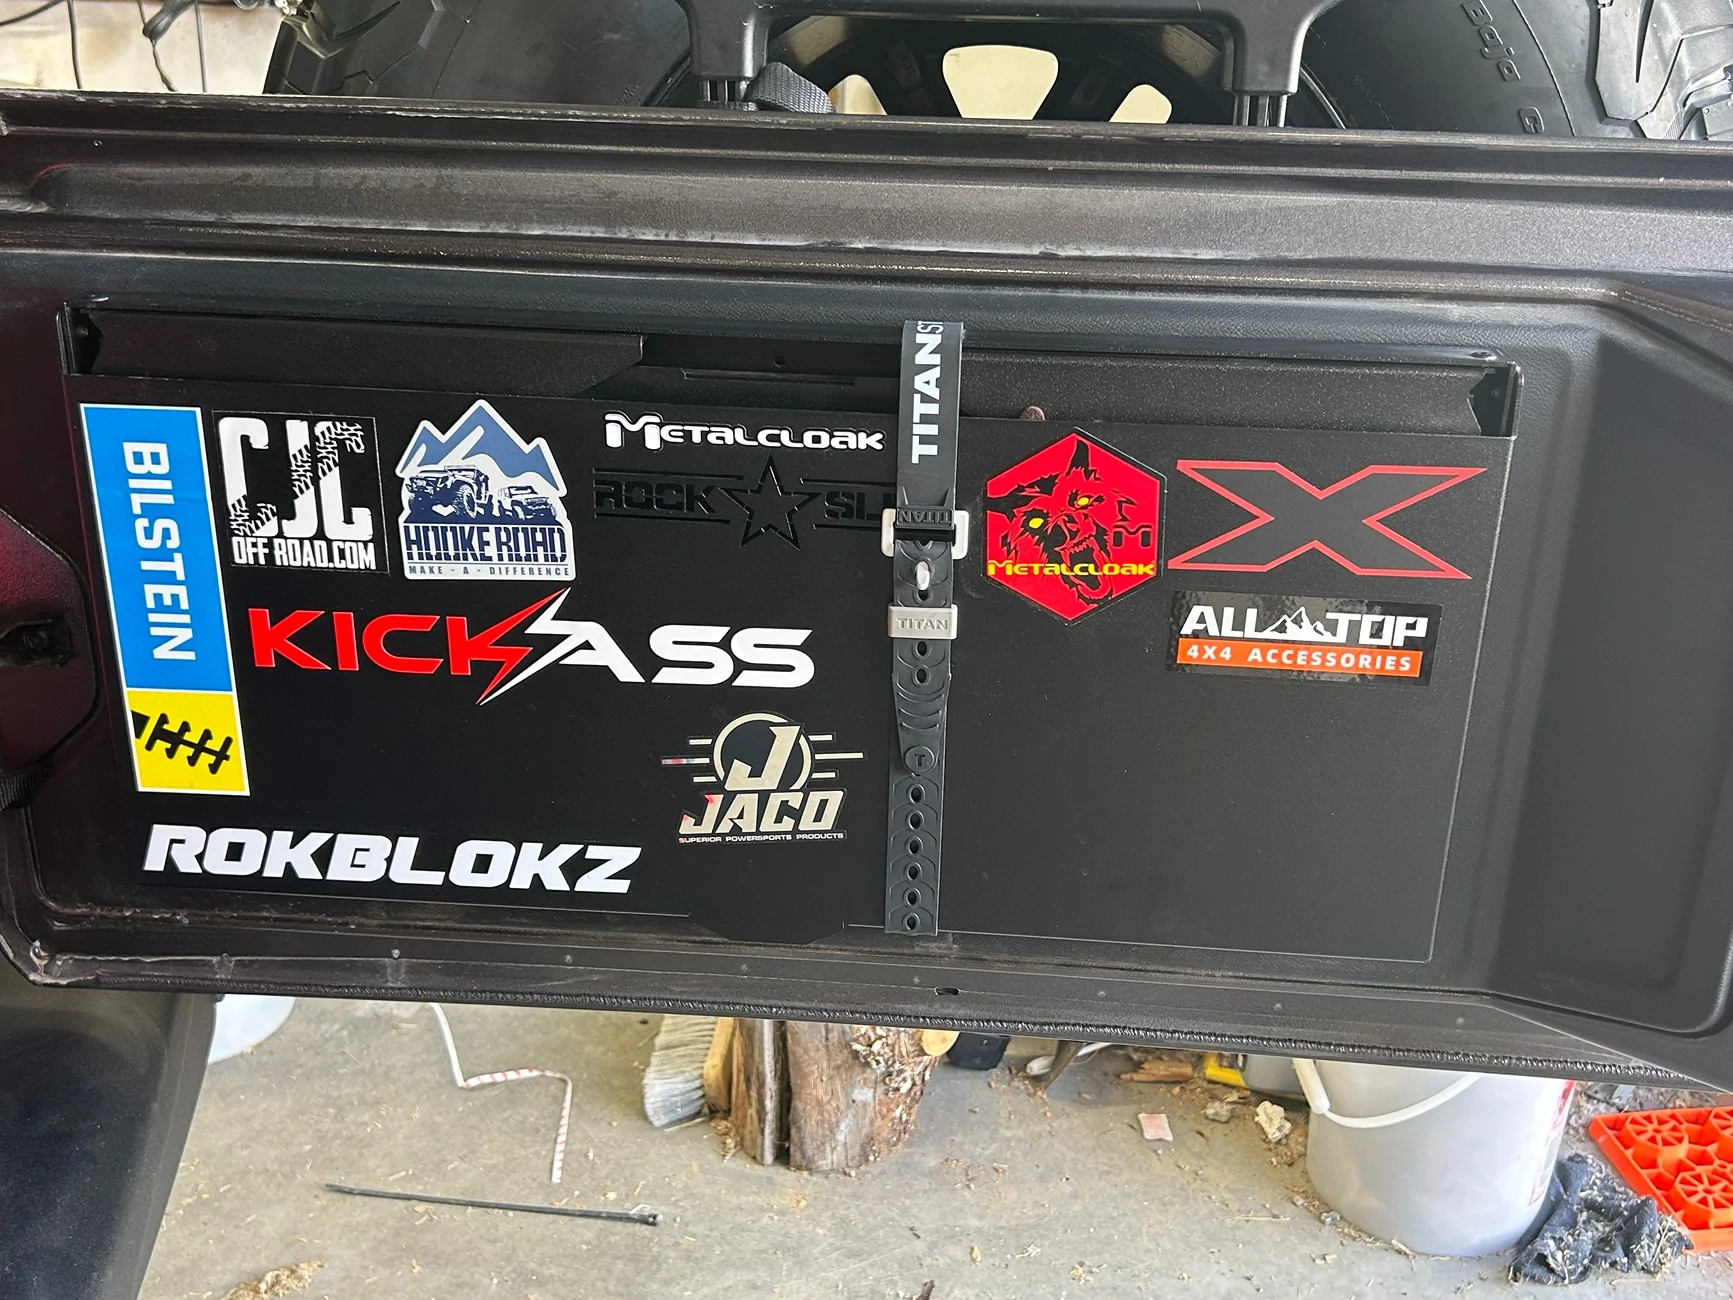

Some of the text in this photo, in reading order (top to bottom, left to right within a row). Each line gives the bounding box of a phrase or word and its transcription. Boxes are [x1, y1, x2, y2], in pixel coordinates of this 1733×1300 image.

[593, 479, 897, 519] ROCK SL
[122, 441, 197, 661] BILSTEIN
[233, 537, 377, 570] OFF ROAD.COM
[404, 525, 568, 563] HOOKE ROAD
[409, 565, 443, 575] MAKE
[490, 566, 570, 576] DIFFERENCE
[896, 617, 949, 631] TITAN
[1187, 644, 1412, 672] 4X4 ACCESSORIES
[679, 790, 845, 835] JACO
[678, 832, 844, 844] SUPERIOR POWERSPORTS PRODUCTS
[143, 824, 643, 894] ROKBLOKZ
